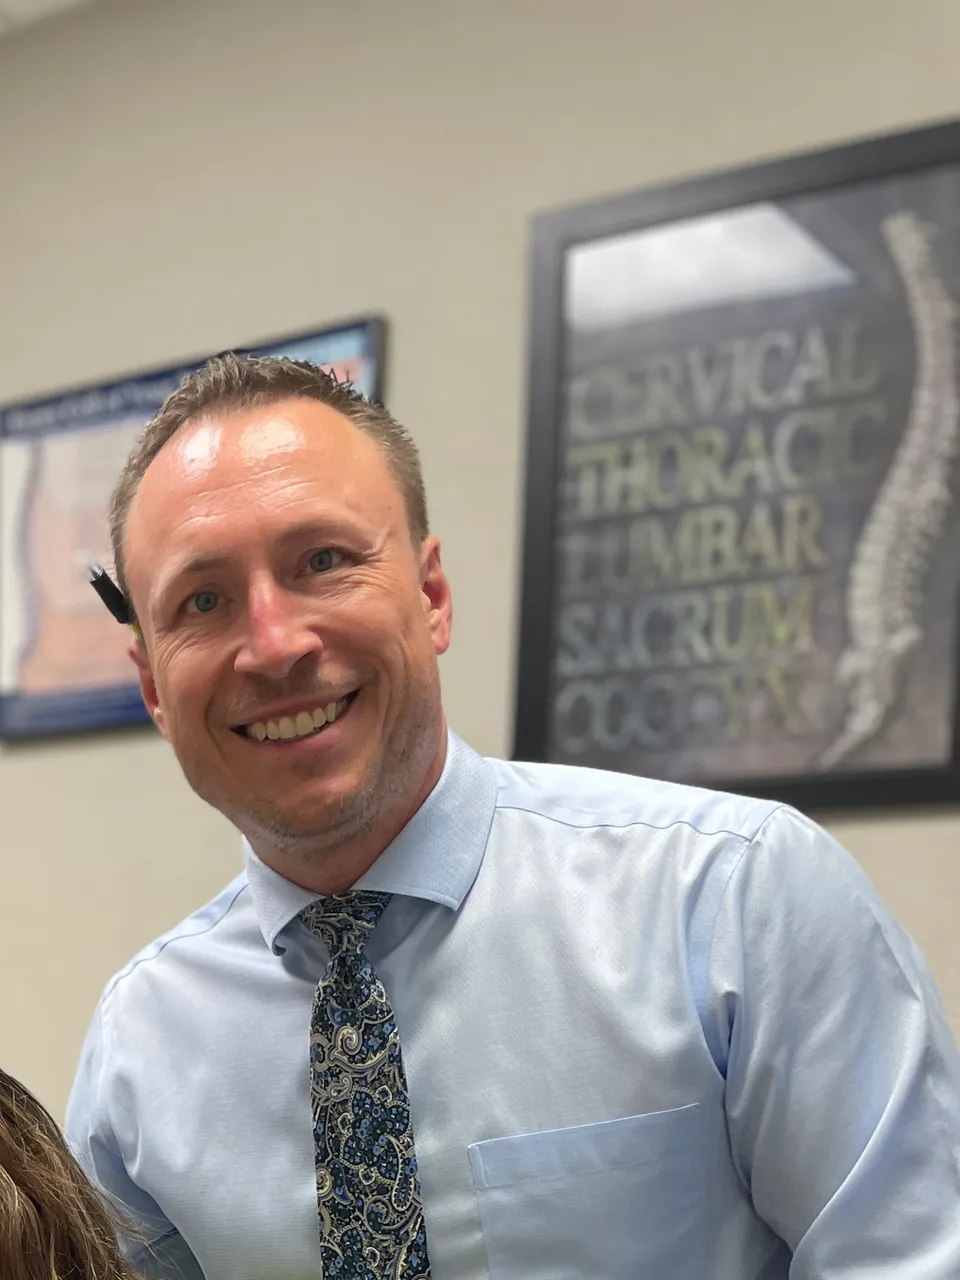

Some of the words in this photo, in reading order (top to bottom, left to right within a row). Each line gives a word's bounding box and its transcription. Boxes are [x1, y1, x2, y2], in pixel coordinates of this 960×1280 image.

[569, 321, 882, 438] CERVICAL
[568, 402, 886, 520] THORACIC
[564, 492, 828, 598] LUMBAR
[558, 576, 816, 678] SACRUM
